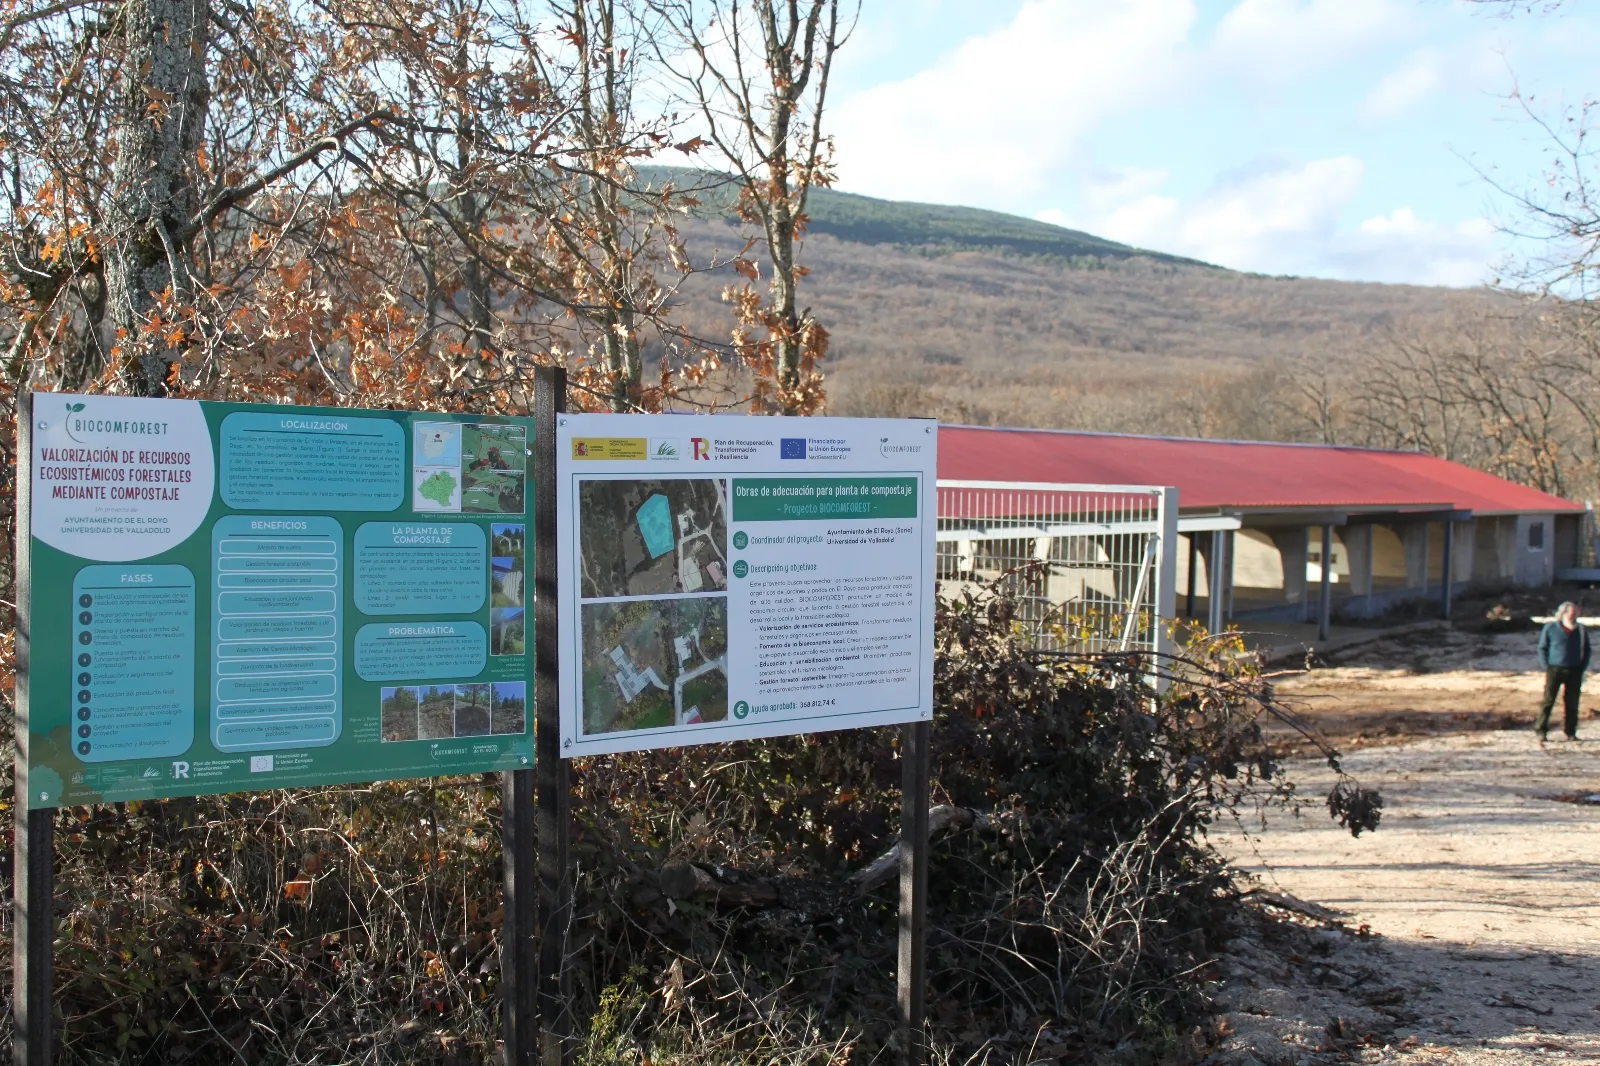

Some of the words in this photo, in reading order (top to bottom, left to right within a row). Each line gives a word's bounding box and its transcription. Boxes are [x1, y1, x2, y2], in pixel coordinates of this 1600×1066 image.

[75, 419, 168, 435] BIOCOMFOREST
[281, 420, 348, 430] LOCALIZACIÓN
[41, 447, 118, 463] VALORIZACIÓN
[122, 451, 135, 463] DE
[139, 452, 191, 465] RECURSOS
[40, 465, 124, 481] ECOSISTÉMICOS
[129, 469, 192, 482] FORESTALES
[52, 486, 106, 499] MEDIANTE
[111, 487, 180, 501] COMPOSTAJE
[736, 486, 758, 497] Obras
[761, 486, 770, 496] de
[773, 485, 814, 496] adecuación
[816, 487, 832, 498] para
[836, 485, 858, 497] planta
[861, 485, 869, 495] de
[871, 485, 912, 497] compostaje
[784, 504, 817, 515] Proyecto
[820, 502, 871, 513] BIOCOMFOREST
[406, 527, 438, 535] PLANTA
[394, 536, 451, 544] COMPOSTAJE
[751, 536, 785, 544] Coordinador
[751, 564, 784, 573] Descripción
[121, 574, 153, 583] FASES
[389, 626, 455, 635] PROBLEMÁTICA
[751, 705, 769, 714] Ayuda
[770, 702, 797, 712] aprobada:
